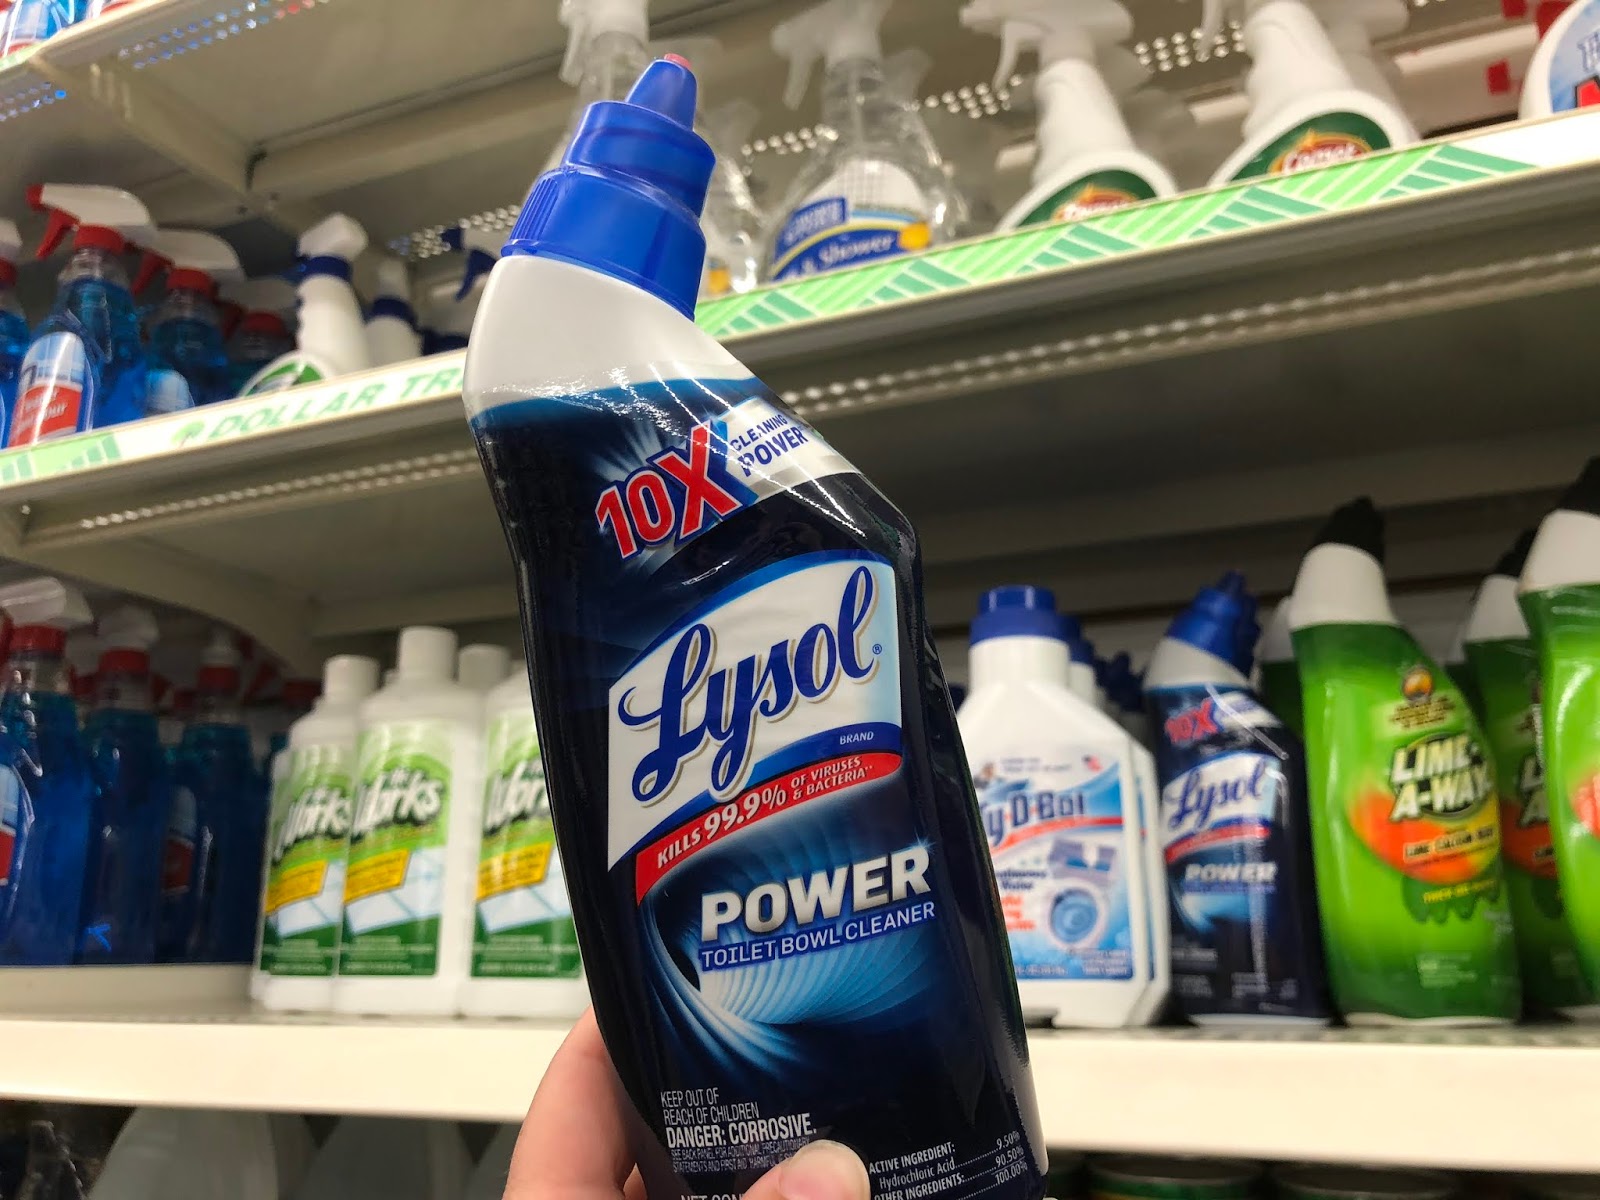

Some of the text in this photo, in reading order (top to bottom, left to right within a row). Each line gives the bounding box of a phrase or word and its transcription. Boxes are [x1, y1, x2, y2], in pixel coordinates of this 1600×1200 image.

[209, 367, 463, 439] DOLLAR TR
[729, 413, 788, 450] CLEANING
[738, 425, 809, 477] POWER
[595, 419, 743, 559] 10X
[839, 730, 874, 746] BRAND
[790, 756, 862, 790] OF VIRUSES
[792, 788, 803, 801] &
[657, 784, 788, 869] KILLS 99.9%
[701, 846, 932, 942] POWER
[702, 901, 936, 968] TOILET BOWL CLEANER
[660, 1087, 720, 1108] KEEP OUT OF
[663, 1102, 760, 1126] REACH OF CHILDREN
[666, 1112, 818, 1149] DANGER: CORROSIVE.
[868, 1142, 955, 1175] ACTIVE INGREDIENT:
[879, 1130, 1021, 1192] Hydrochloric Acid 9.50%
[905, 1172, 965, 1199] INGREDIENTS:
[995, 1145, 1025, 1169] 90.50%
[994, 1162, 1028, 1185] 100.00%
